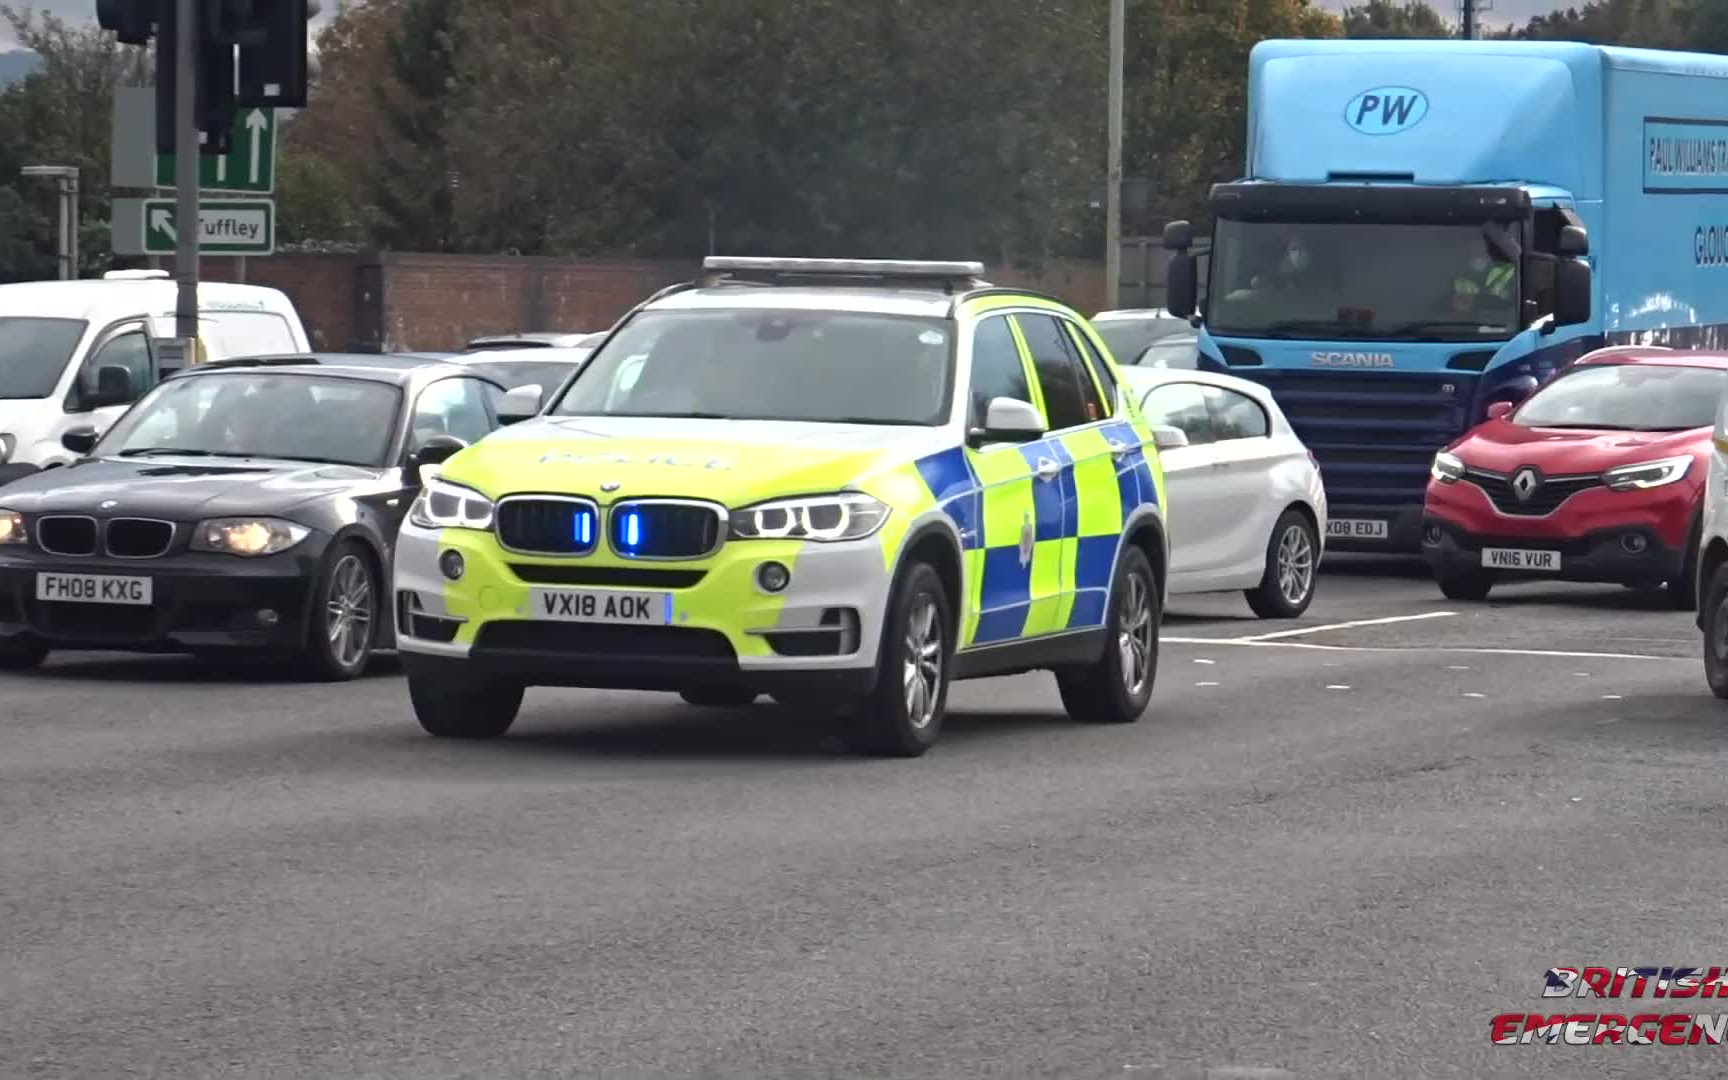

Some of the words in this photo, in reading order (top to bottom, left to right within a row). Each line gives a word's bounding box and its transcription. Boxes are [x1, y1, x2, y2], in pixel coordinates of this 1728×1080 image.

[1355, 95, 1419, 125] PW
[1650, 138, 1673, 172] PAUL
[1675, 138, 1715, 173] WILLIAMS
[1311, 352, 1394, 367] SCANIA
[1355, 521, 1383, 535] EDJ
[1491, 551, 1520, 566] VN16
[1525, 552, 1552, 567] VUR
[45, 577, 96, 598] FH08
[102, 580, 143, 600] KXG
[543, 592, 596, 617] VX18
[604, 595, 650, 619] AOK
